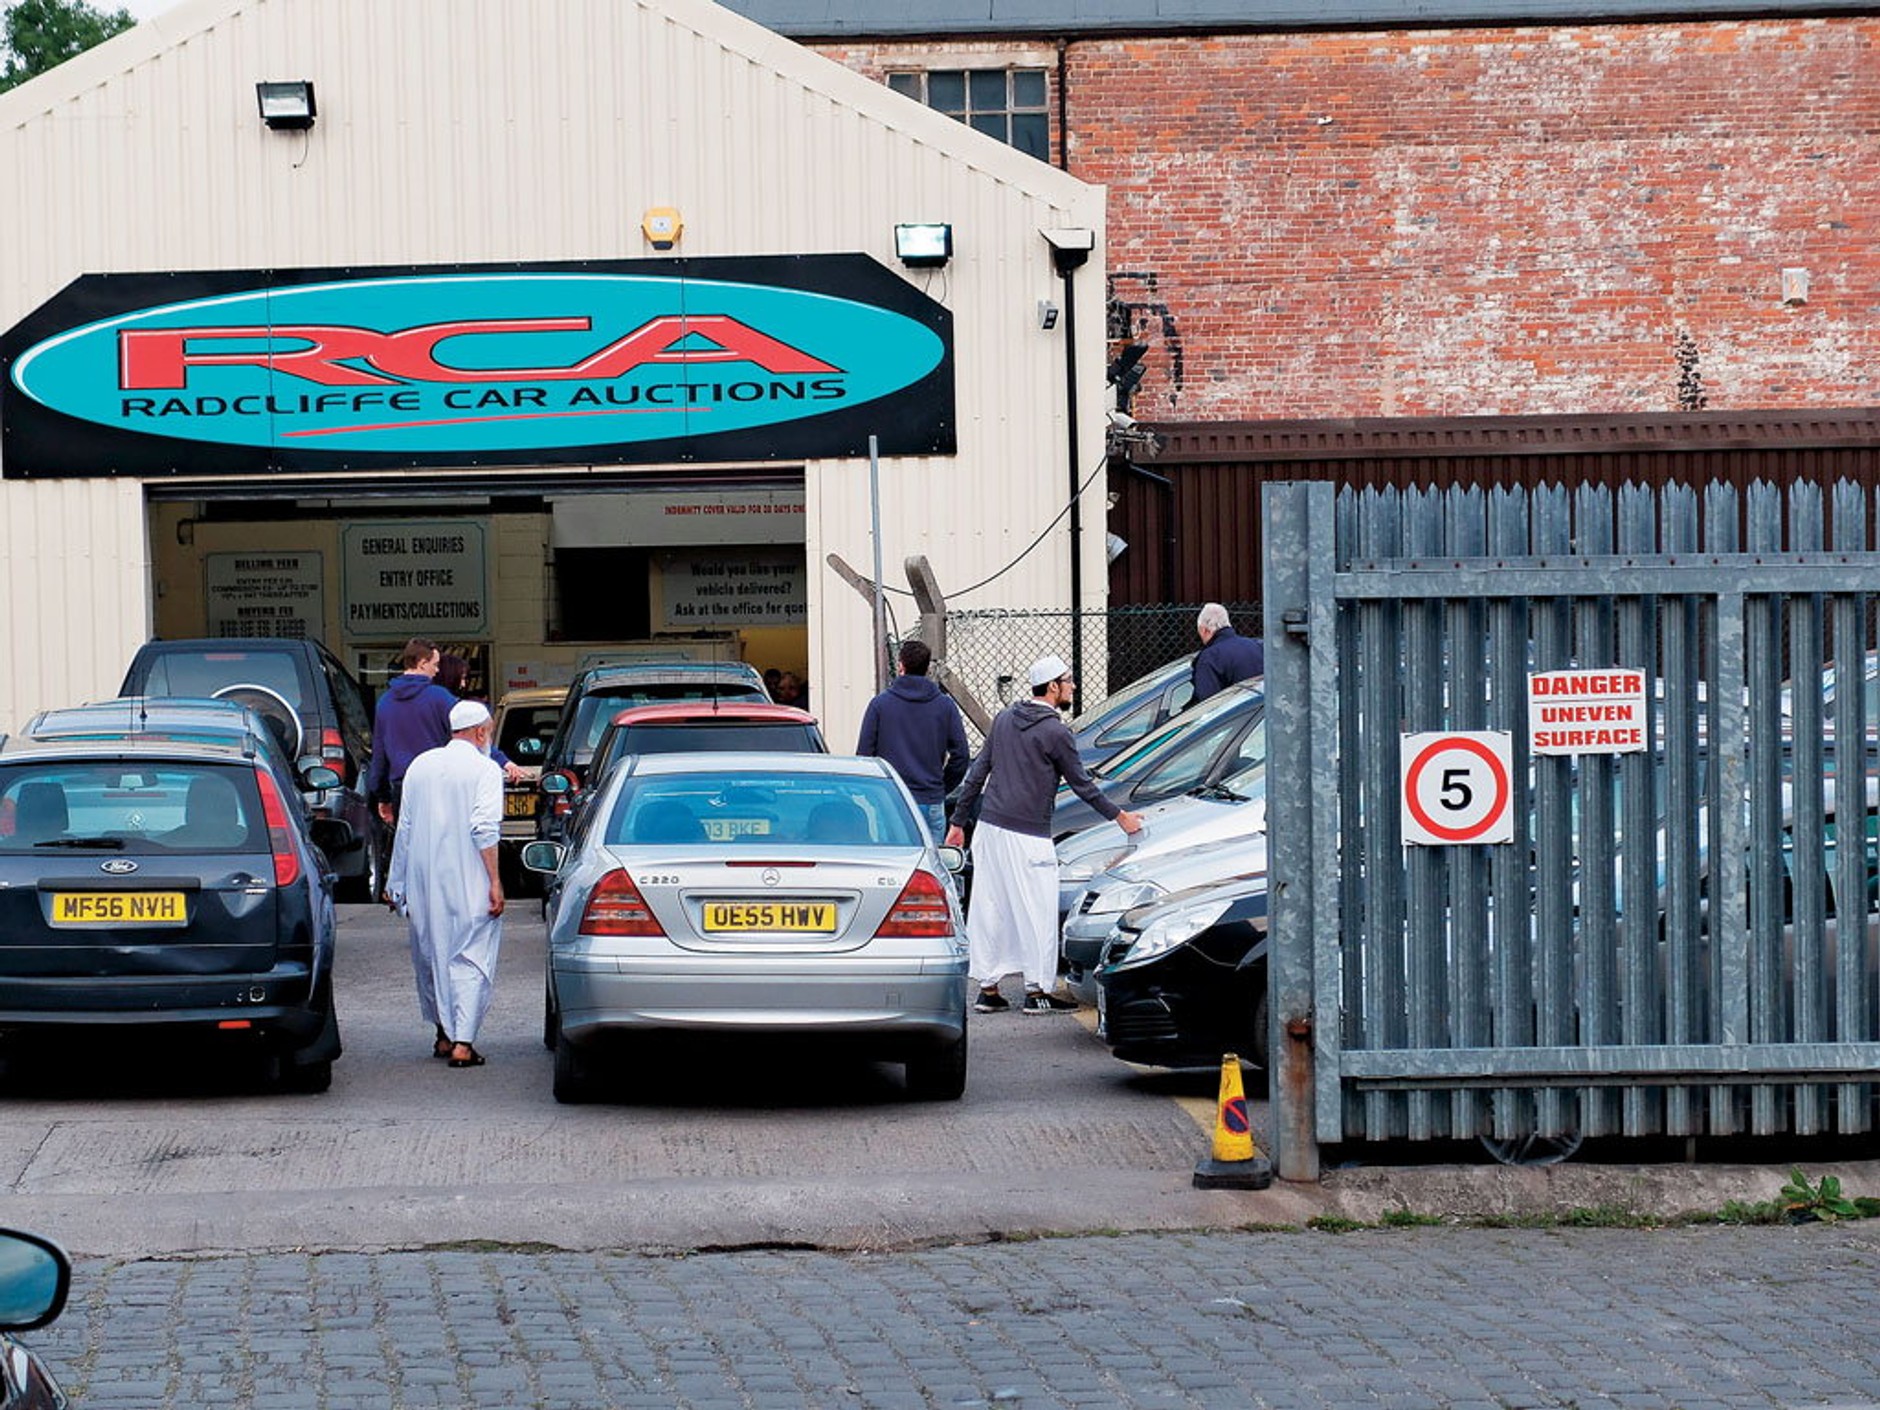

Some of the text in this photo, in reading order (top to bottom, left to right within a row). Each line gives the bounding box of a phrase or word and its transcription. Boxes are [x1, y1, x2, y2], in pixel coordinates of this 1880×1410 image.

[117, 313, 848, 390] RCA
[121, 379, 847, 417] RADCLIFFE CAR AUCTIONS
[703, 505, 724, 515] COVER
[727, 505, 746, 514] VALID
[748, 505, 761, 514] FOR
[361, 536, 465, 555] GENERAL ENQUIRIES
[379, 569, 454, 587] ENTRY OFFICE
[690, 562, 796, 578] Would you like your
[696, 581, 792, 596] vehicle delivered?
[350, 602, 480, 620] PAYMENTS/COLLECTIONS
[674, 602, 695, 616] Ask
[698, 603, 709, 615] at
[712, 602, 729, 614] the
[733, 602, 763, 615] office
[766, 602, 781, 614] for
[1532, 675, 1641, 696] DANGER
[1541, 705, 1633, 723] UNEVEN
[1534, 728, 1641, 747] SURFACE
[1440, 769, 1473, 811] 5
[639, 875, 680, 885] C 220
[63, 896, 175, 918] MF56 NVH
[714, 903, 826, 926] OE55 HWV
